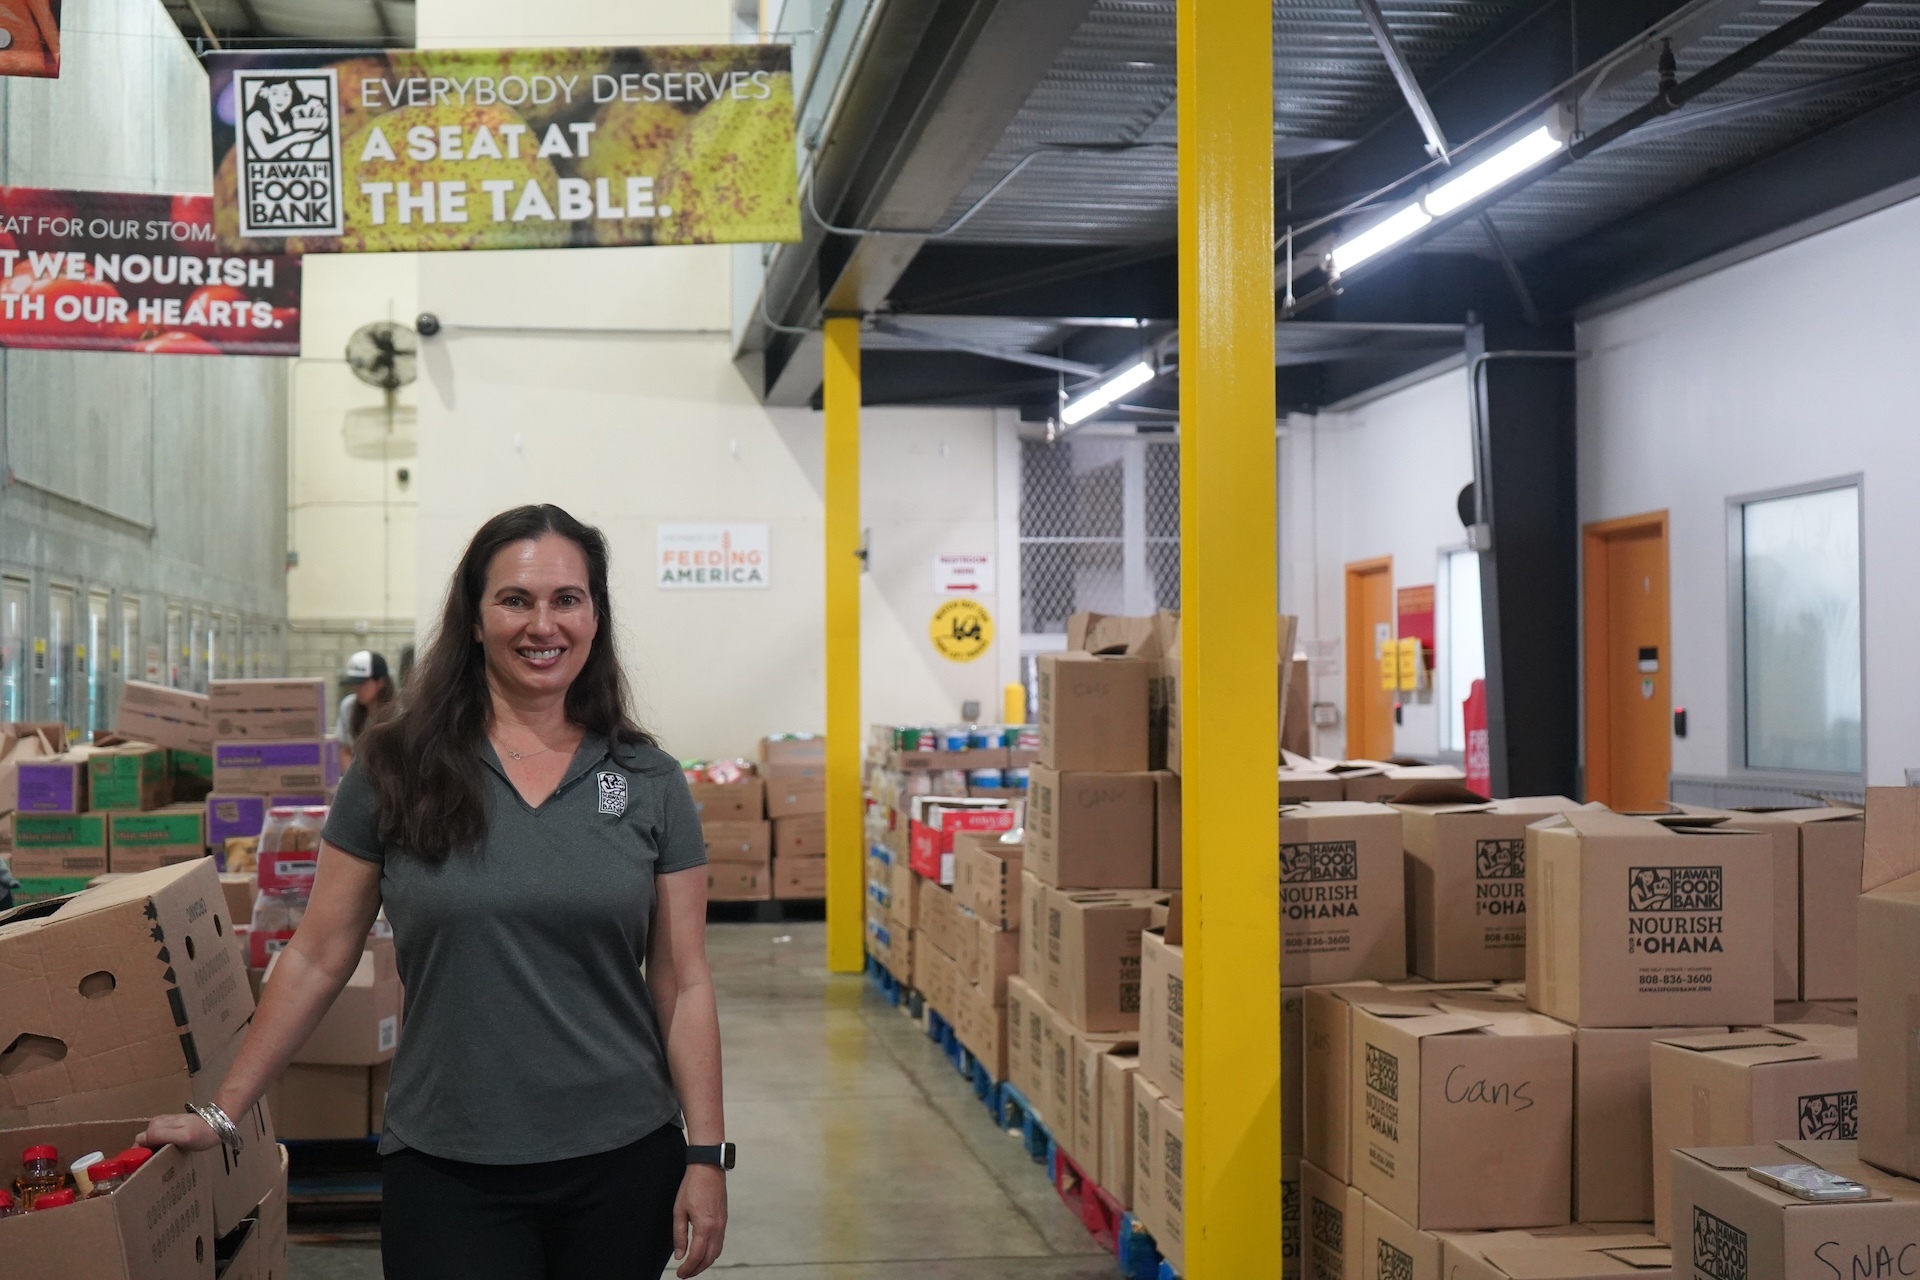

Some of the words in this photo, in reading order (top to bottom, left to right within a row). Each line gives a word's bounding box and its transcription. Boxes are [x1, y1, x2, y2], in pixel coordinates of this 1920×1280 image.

[361, 75, 579, 107] EVERYBODY
[592, 70, 771, 103] DESERVES
[360, 126, 396, 161] A
[406, 124, 526, 161] SEAT
[537, 122, 596, 158] AT
[251, 180, 328, 201] FOOD
[361, 181, 468, 224] THE
[482, 176, 672, 222] TABLE.
[253, 202, 328, 223] BANK
[38, 216, 84, 237] FOR
[88, 218, 140, 239] OUR
[144, 220, 217, 242] STOM
[27, 250, 86, 281] WE
[94, 252, 274, 288] NOURISH
[54, 294, 129, 323] OUR
[138, 297, 283, 329] HEARTS.
[663, 549, 762, 567] FEEDING
[662, 568, 764, 584] AMERICA
[1313, 853, 1354, 866] FOOD
[1313, 866, 1354, 879] BANK
[1673, 880, 1719, 894] FOOD
[1673, 894, 1719, 908] BANK
[1629, 917, 1722, 934] NOURISH
[1639, 974, 1712, 984] 808-836-3600
[1445, 1064, 1534, 1112] Cans
[1717, 1238, 1745, 1270] FOOD
